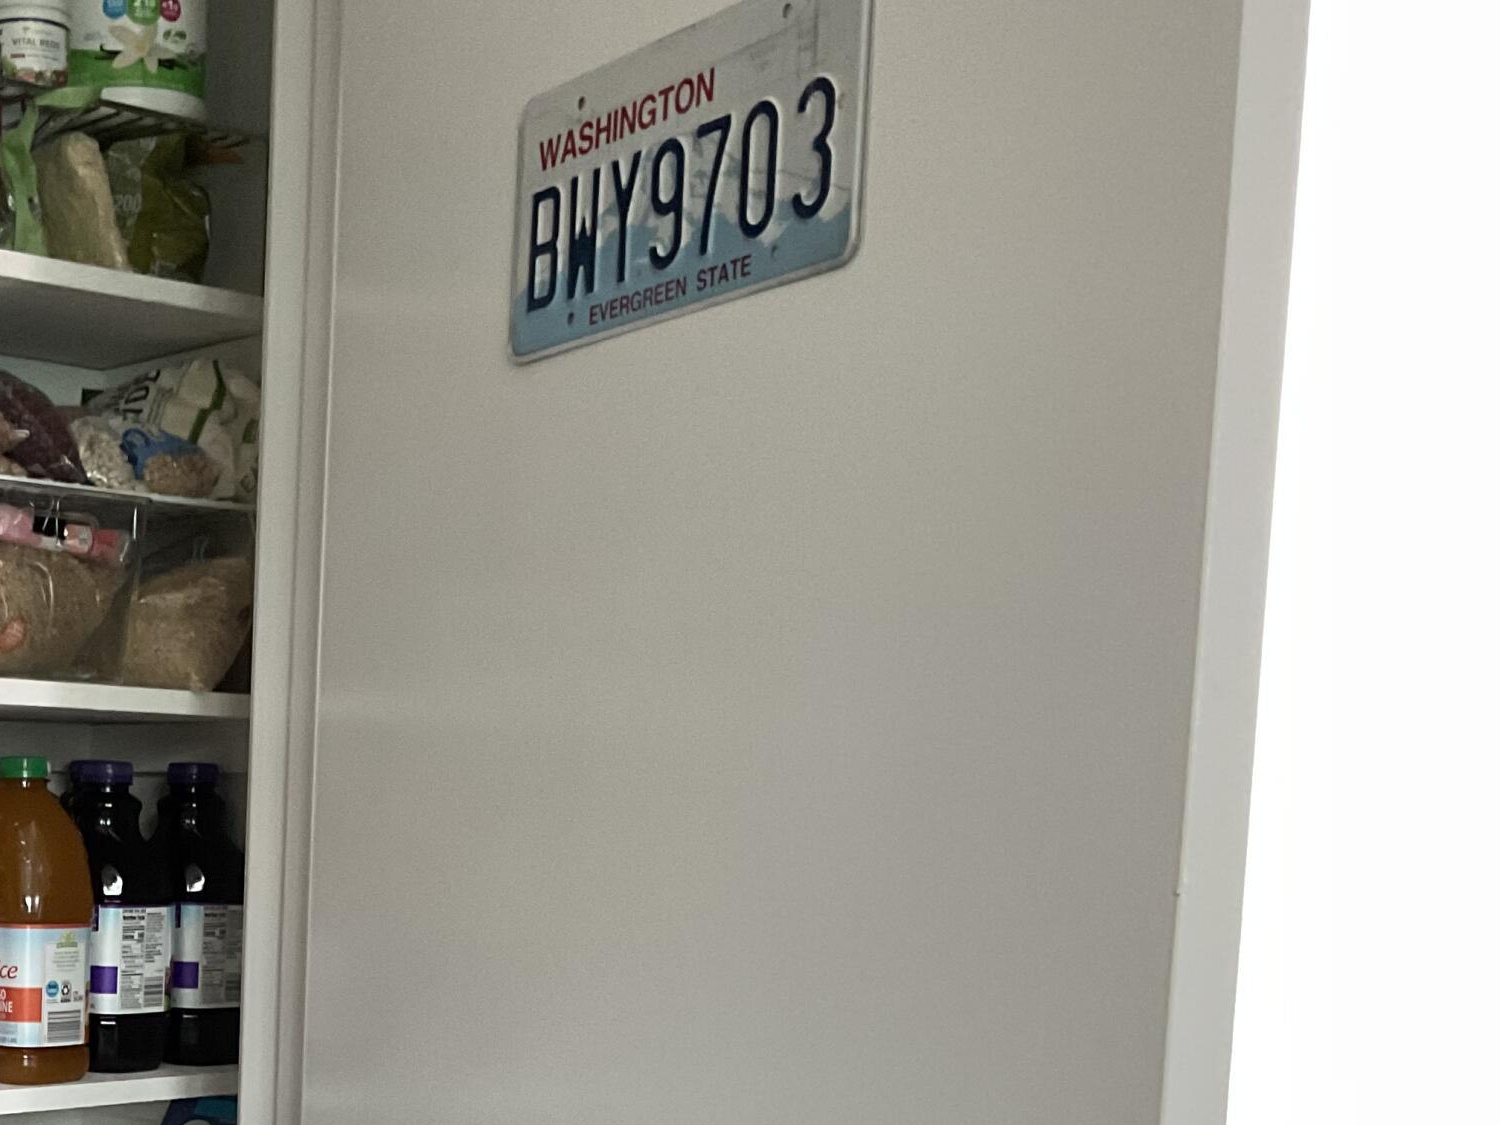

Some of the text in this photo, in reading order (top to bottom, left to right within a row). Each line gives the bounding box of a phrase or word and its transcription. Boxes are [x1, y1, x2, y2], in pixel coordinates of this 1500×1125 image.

[538, 67, 716, 171] WASHINGTON
[526, 76, 836, 313] BWY9703
[588, 254, 752, 326] EVERGREEN STATE
